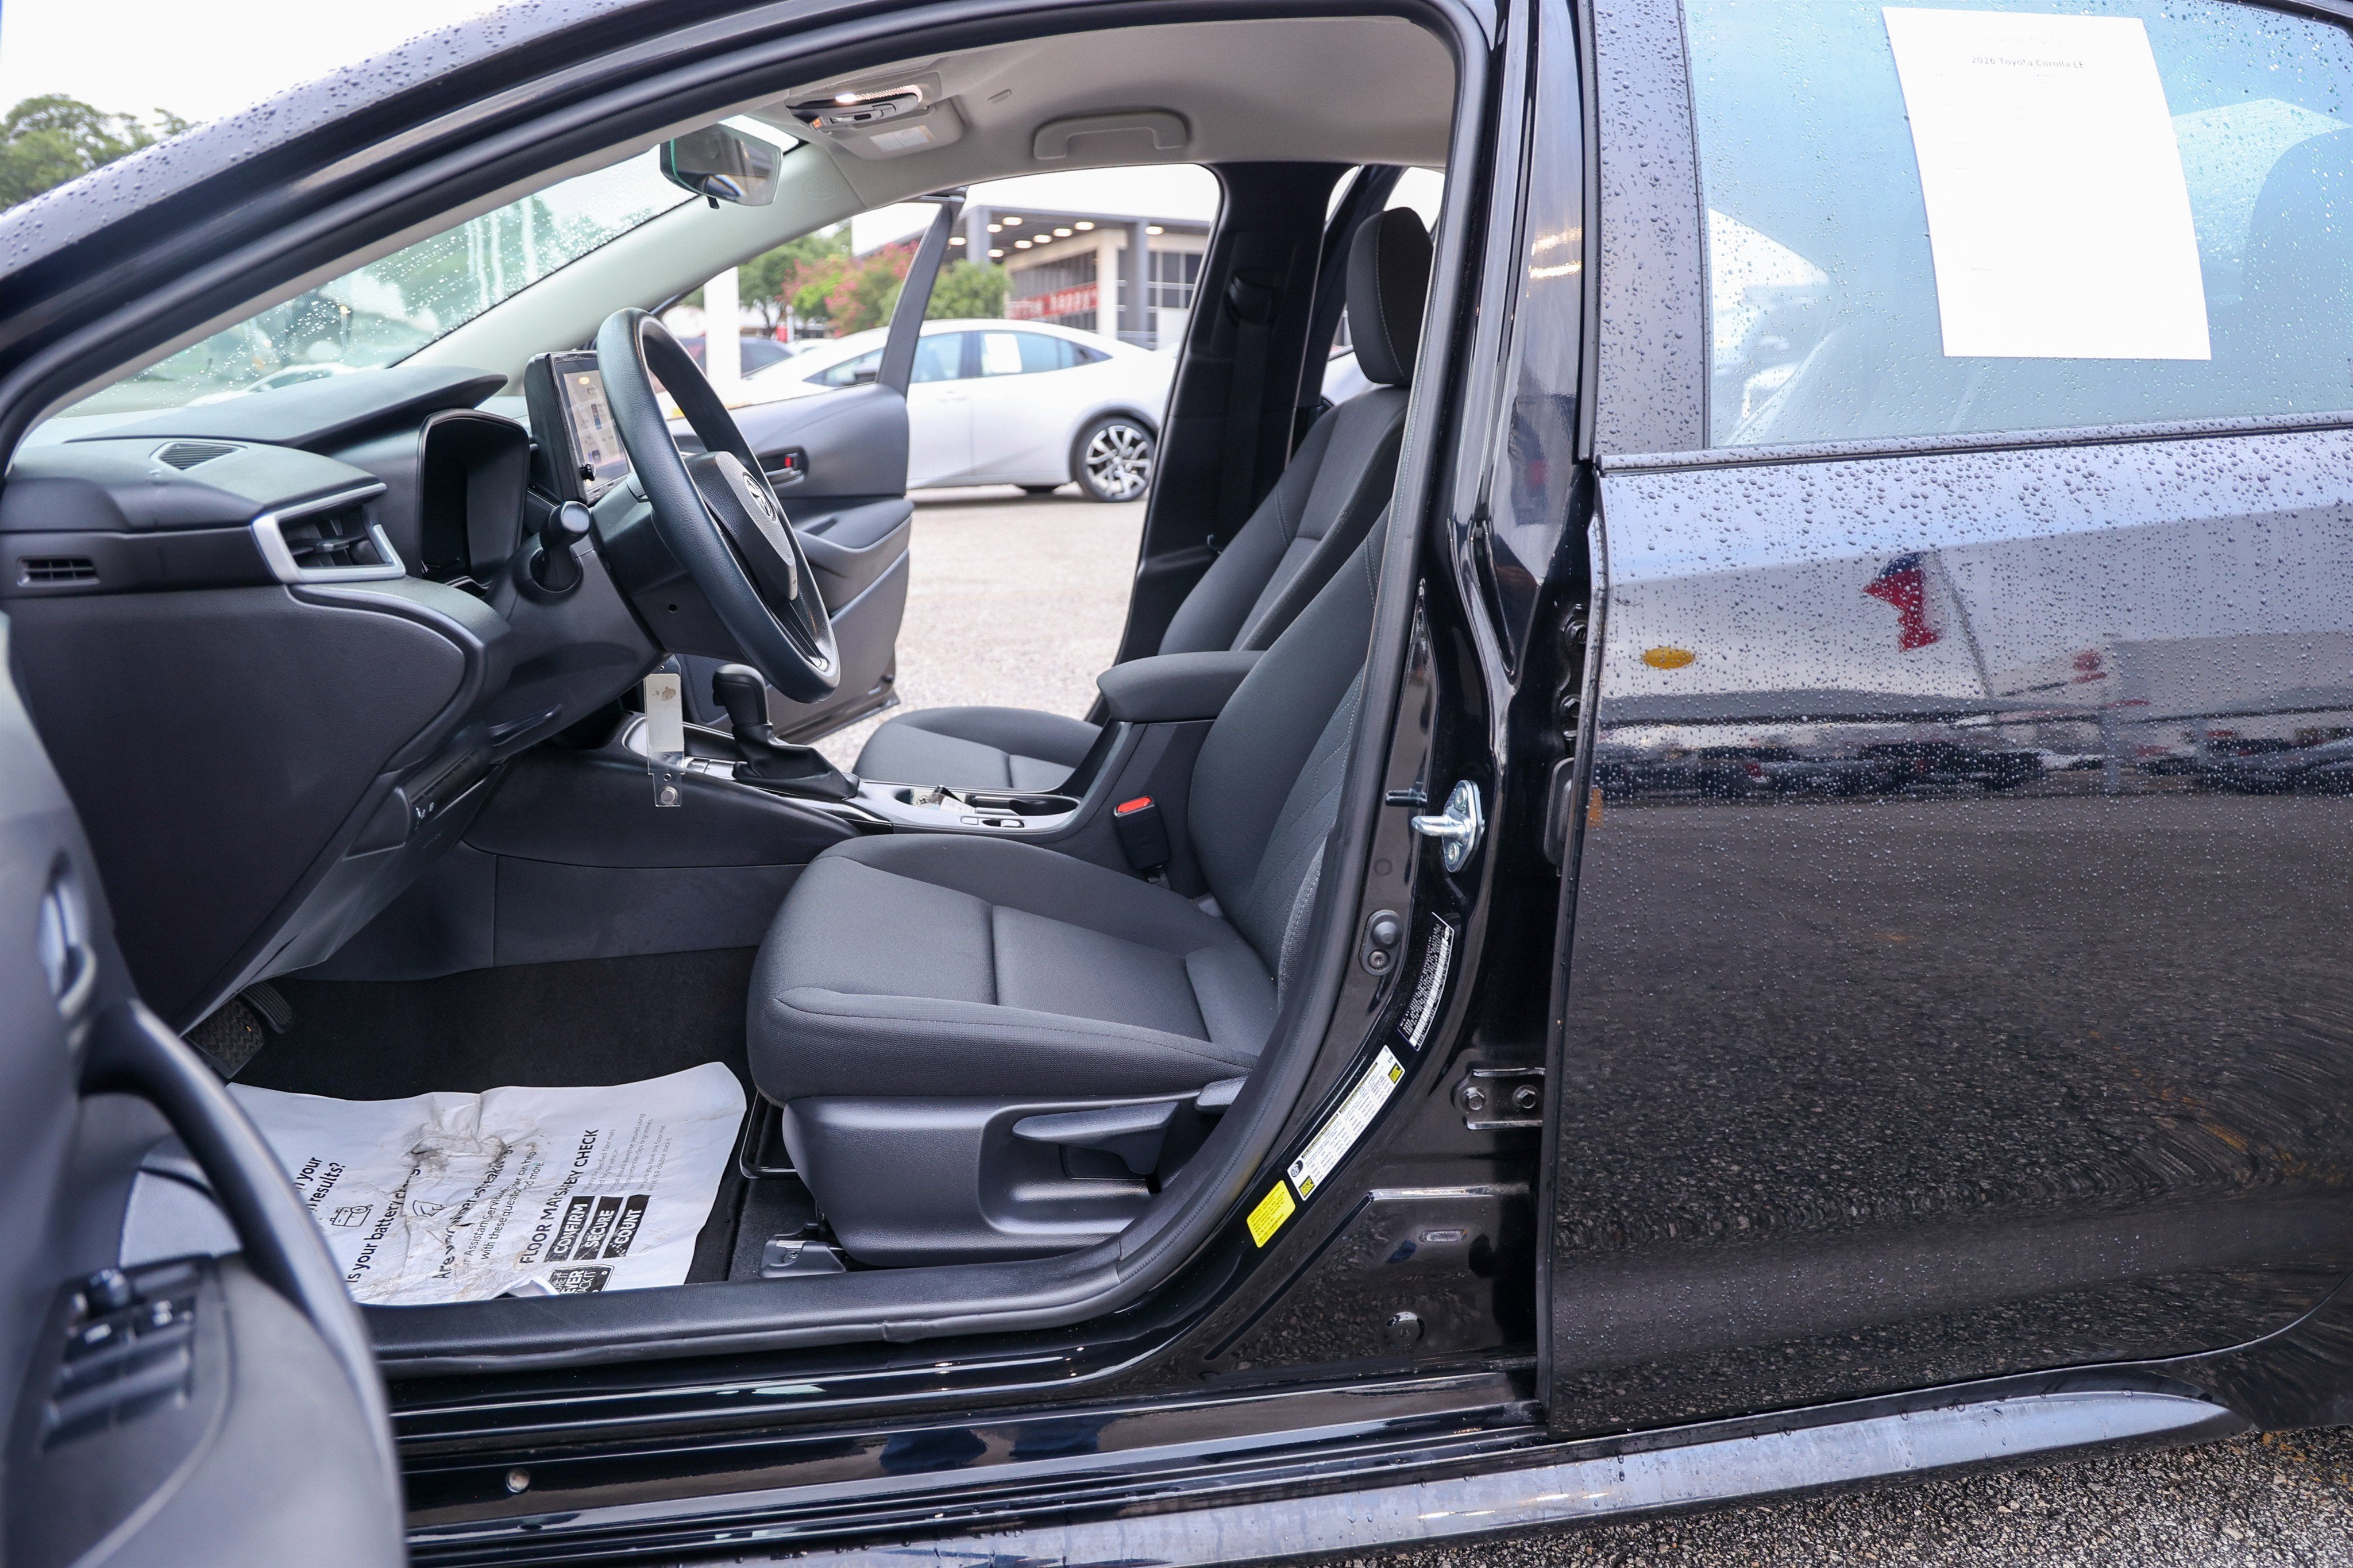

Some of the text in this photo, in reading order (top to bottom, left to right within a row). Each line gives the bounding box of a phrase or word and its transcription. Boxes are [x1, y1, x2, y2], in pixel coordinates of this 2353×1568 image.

[1972, 56, 1996, 64] 2026
[1999, 57, 2033, 67] Toyota
[2036, 59, 2070, 68] Corolla
[637, 1114, 646, 1126] using
[521, 1151, 538, 1164] help
[602, 1141, 611, 1152] floor
[647, 1153, 657, 1164] have
[654, 1134, 662, 1144] floor
[297, 1157, 322, 1181] your
[655, 1153, 667, 1169] double
[309, 1163, 346, 1202] results?
[519, 1224, 552, 1264] FLOOR
[540, 1198, 563, 1220] MAT
[553, 1170, 584, 1196] SAFETY
[574, 1129, 599, 1167] CHECK
[364, 1200, 404, 1240] battery
[488, 1218, 507, 1239] these
[553, 1204, 588, 1254] CONFIRM
[583, 1210, 615, 1248] SECURE
[614, 1210, 642, 1244] COUNT
[352, 1243, 378, 1270] your
[481, 1242, 496, 1260] with
[342, 1273, 361, 1283] Is
[431, 1256, 455, 1279] Are
[560, 1270, 584, 1293] EVER
